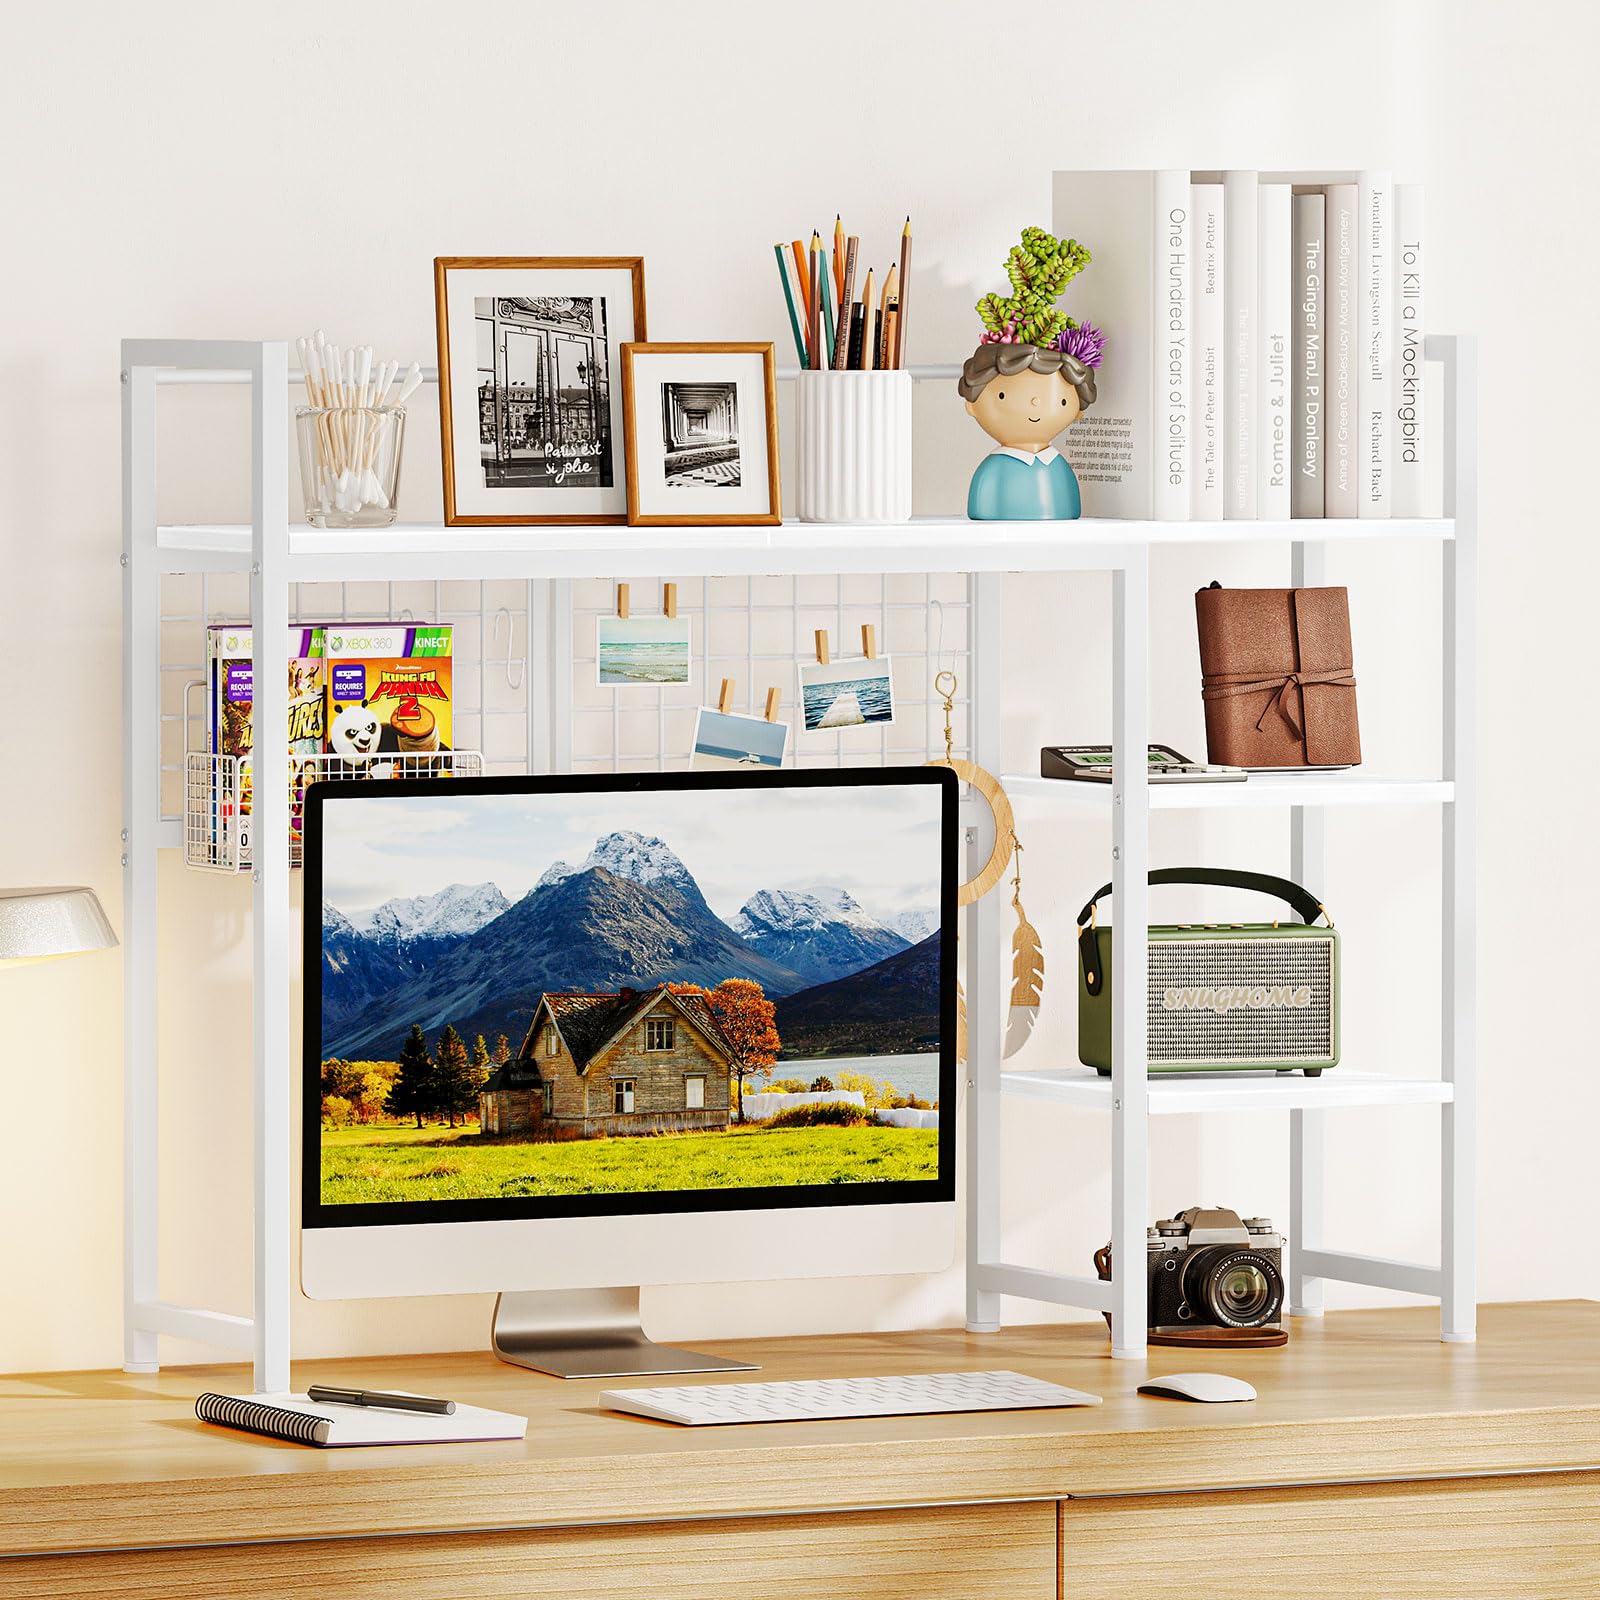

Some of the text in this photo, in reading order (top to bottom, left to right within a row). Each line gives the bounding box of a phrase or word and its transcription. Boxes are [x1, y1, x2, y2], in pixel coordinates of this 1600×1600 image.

[1205, 211, 1216, 294] Beatrix Potter
[1306, 240, 1320, 269] The
[1338, 209, 1351, 287] Montgomery
[1302, 274, 1320, 330] Ginger
[1368, 189, 1383, 381] Jonathan Livingston Seagull
[1338, 290, 1348, 325] Maud
[1169, 208, 1186, 486] One Hundred Years of Solitude
[1397, 241, 1420, 463] To Kill a Mockingbird
[1205, 347, 1215, 491] The Tale of Peter Rabbit
[1269, 334, 1285, 487] Romeo & Juliet
[1337, 402, 1348, 441] Green
[544, 440, 603, 458] Paris est
[1302, 402, 1320, 478] Donleavy
[1371, 411, 1383, 502] Richard Bach
[545, 457, 593, 484] si jolie
[1337, 459, 1348, 491] Anne
[345, 637, 393, 650] XBOX 360
[415, 637, 449, 649] KINECT
[335, 682, 363, 692] REQUIRES
[369, 680, 449, 705] PANDA
[381, 670, 436, 683] KUNG FU
[397, 696, 421, 721] 2
